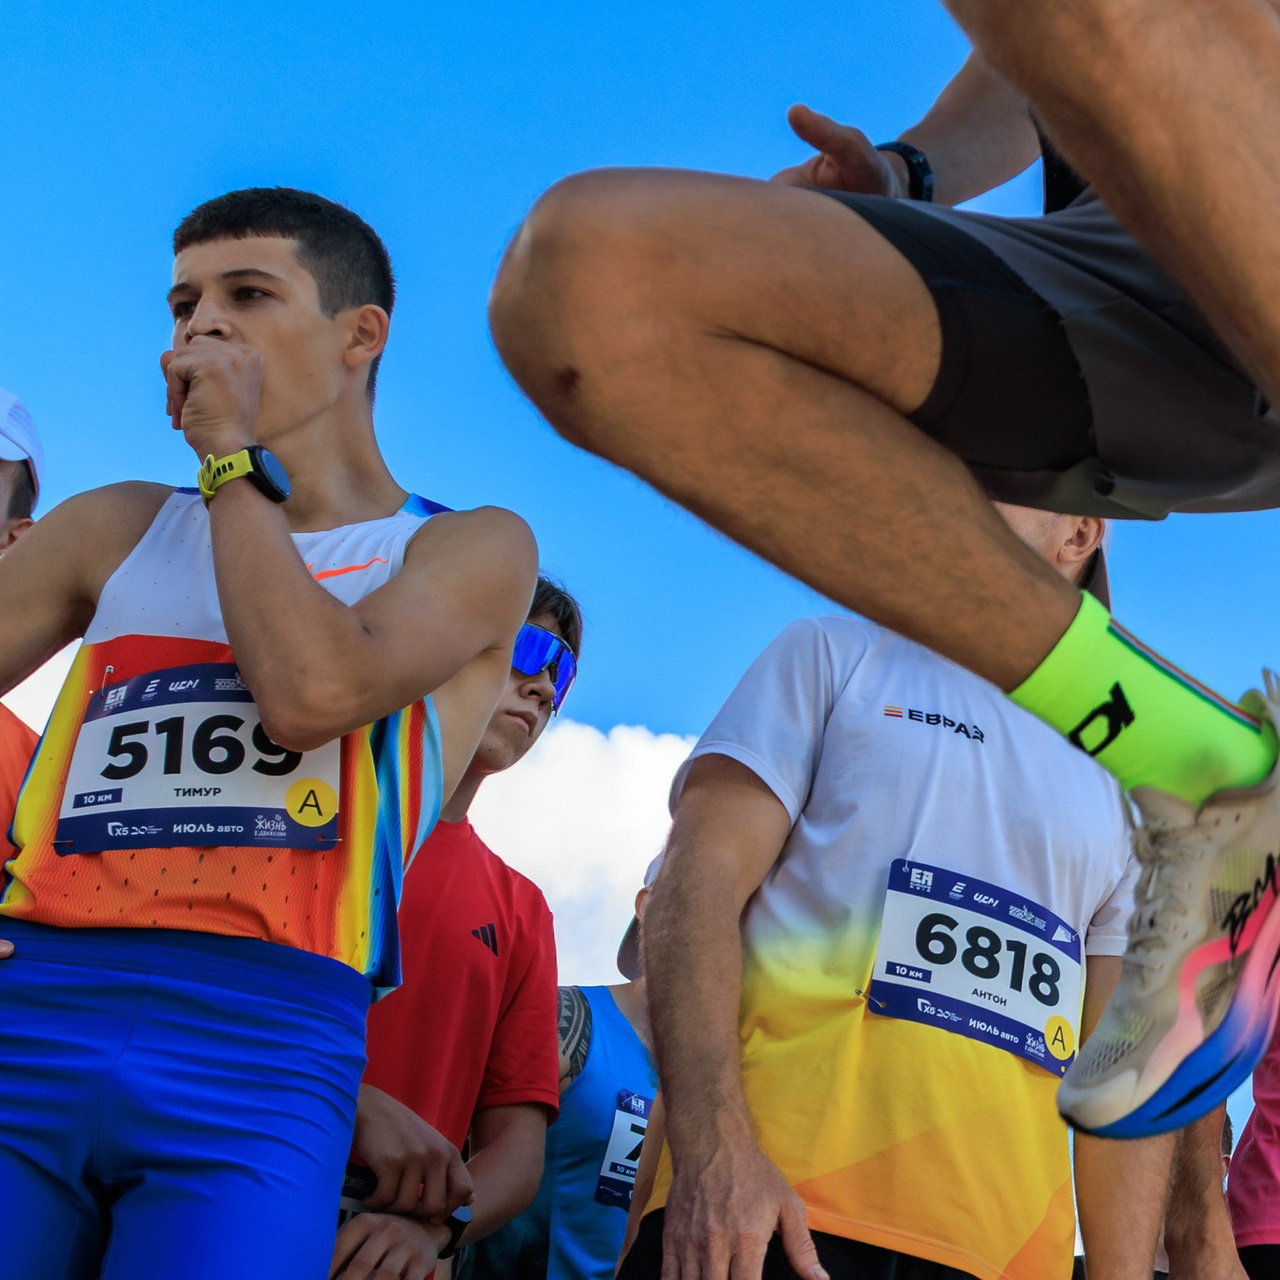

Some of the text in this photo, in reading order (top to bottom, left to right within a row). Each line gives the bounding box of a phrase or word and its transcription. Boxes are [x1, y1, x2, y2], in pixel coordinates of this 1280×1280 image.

[908, 708, 985, 744] ЕВРАЗ
[100, 714, 303, 780] 5169
[83, 794, 96, 805] 10
[174, 787, 222, 798] ТИМУР
[172, 822, 215, 834] ИЮЛЬ
[217, 824, 244, 834] авто
[915, 912, 1061, 1007] 6818
[895, 965, 908, 975] 10
[971, 988, 1008, 1007] АНТОН
[968, 1018, 1019, 1044] ИЮЛЬ авто
[617, 1165, 625, 1173] 10
